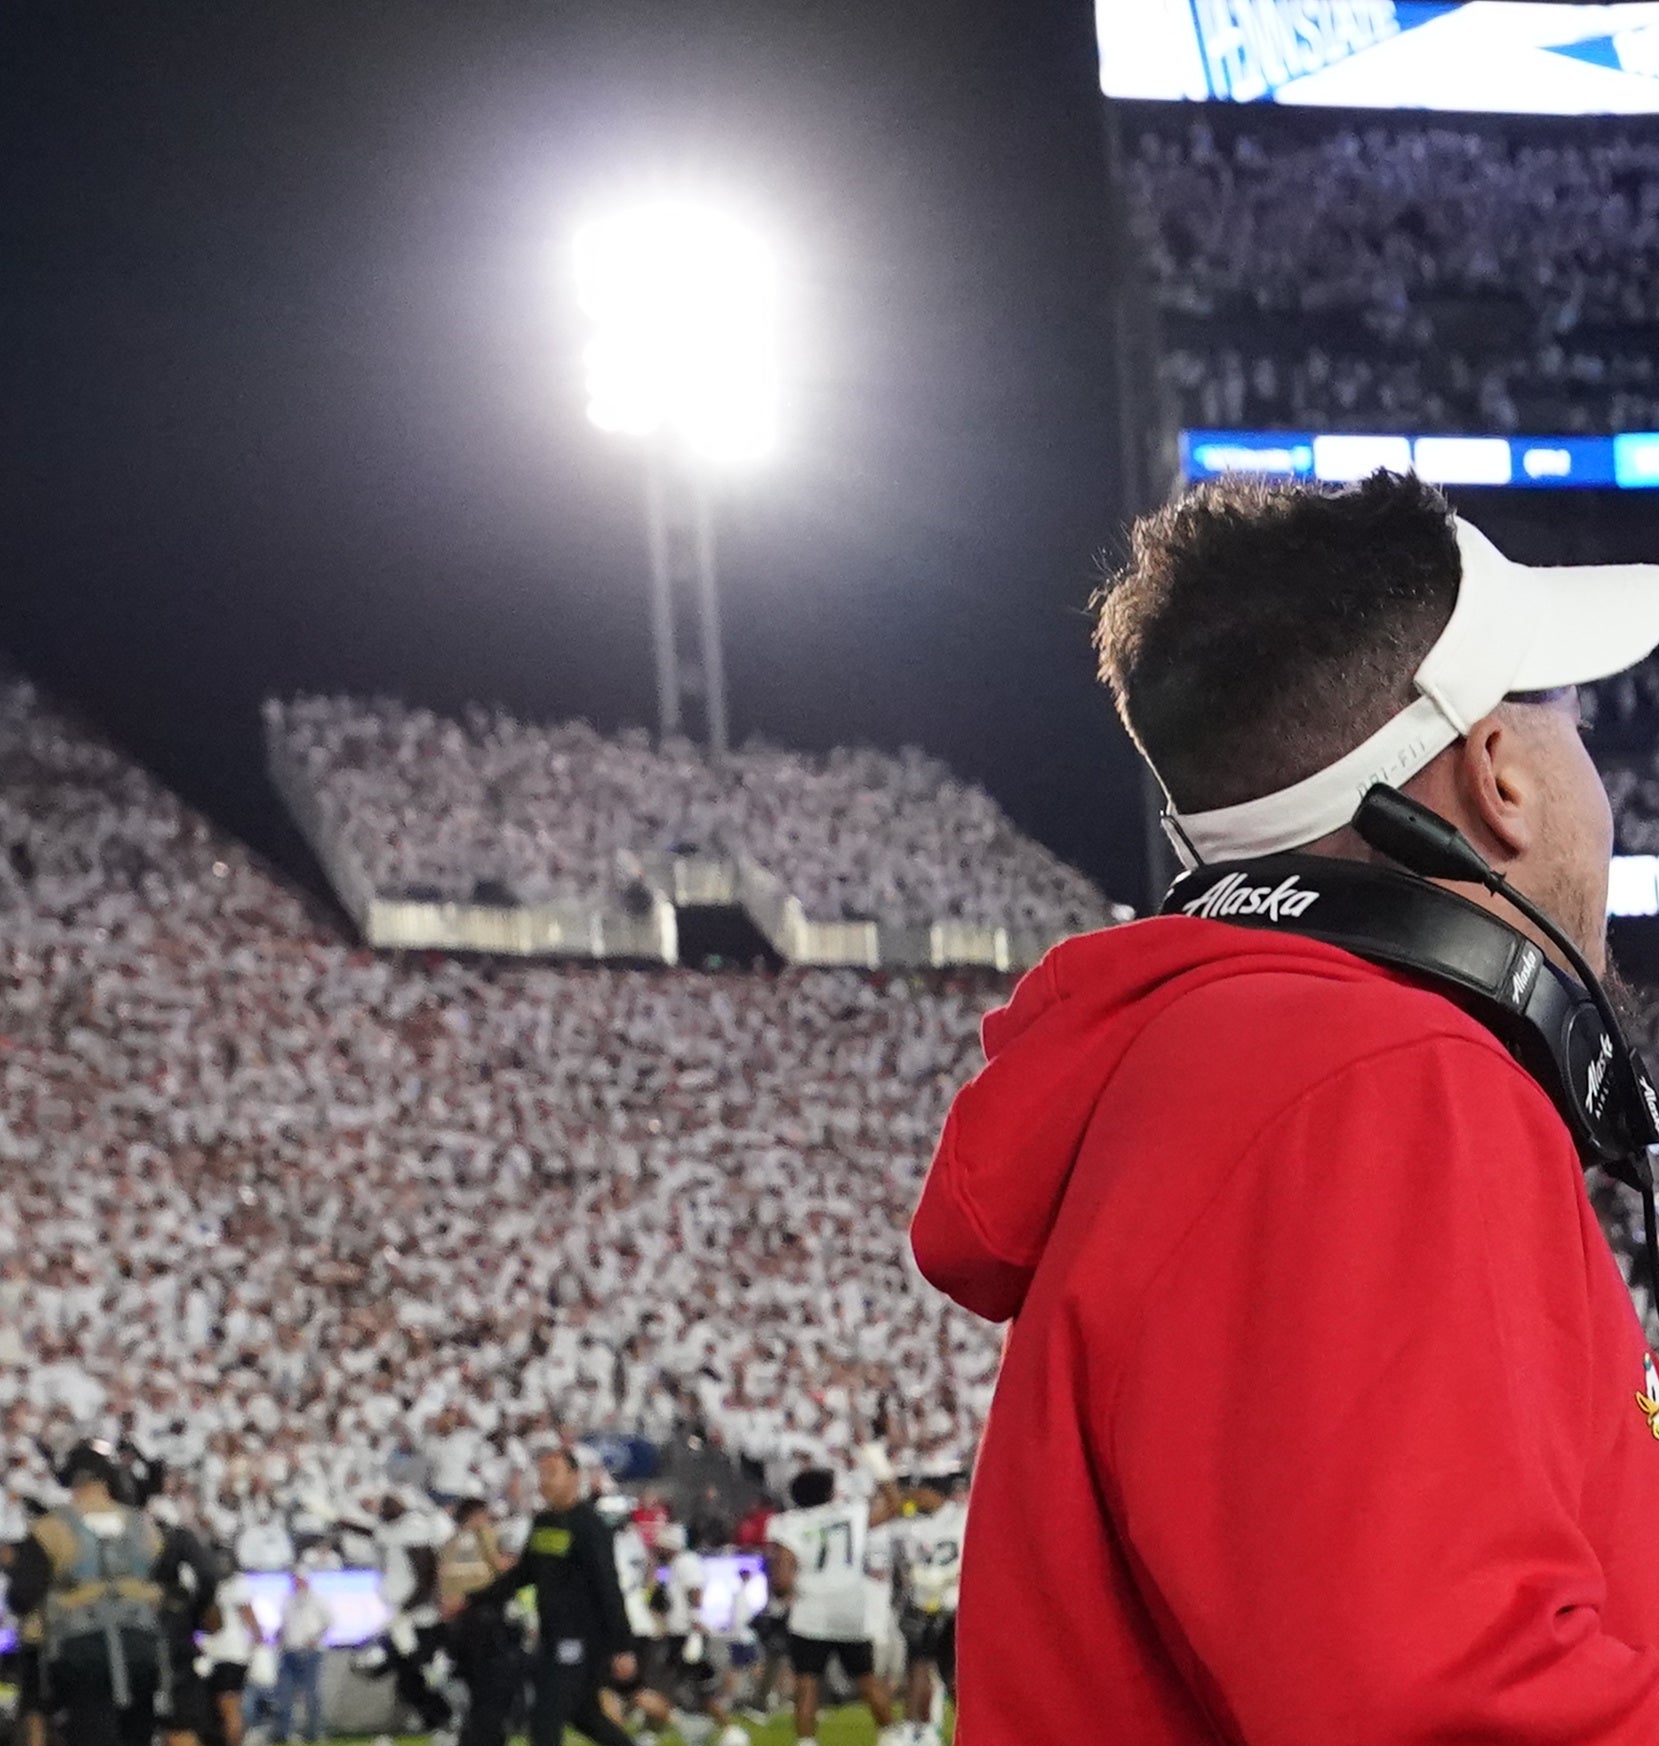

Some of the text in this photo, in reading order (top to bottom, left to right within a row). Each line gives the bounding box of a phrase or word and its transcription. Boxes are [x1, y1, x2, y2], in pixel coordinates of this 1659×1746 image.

[1182, 872, 1320, 922] Alaska
[1512, 950, 1537, 1005] Alaska
[1585, 1033, 1613, 1114] Alask
